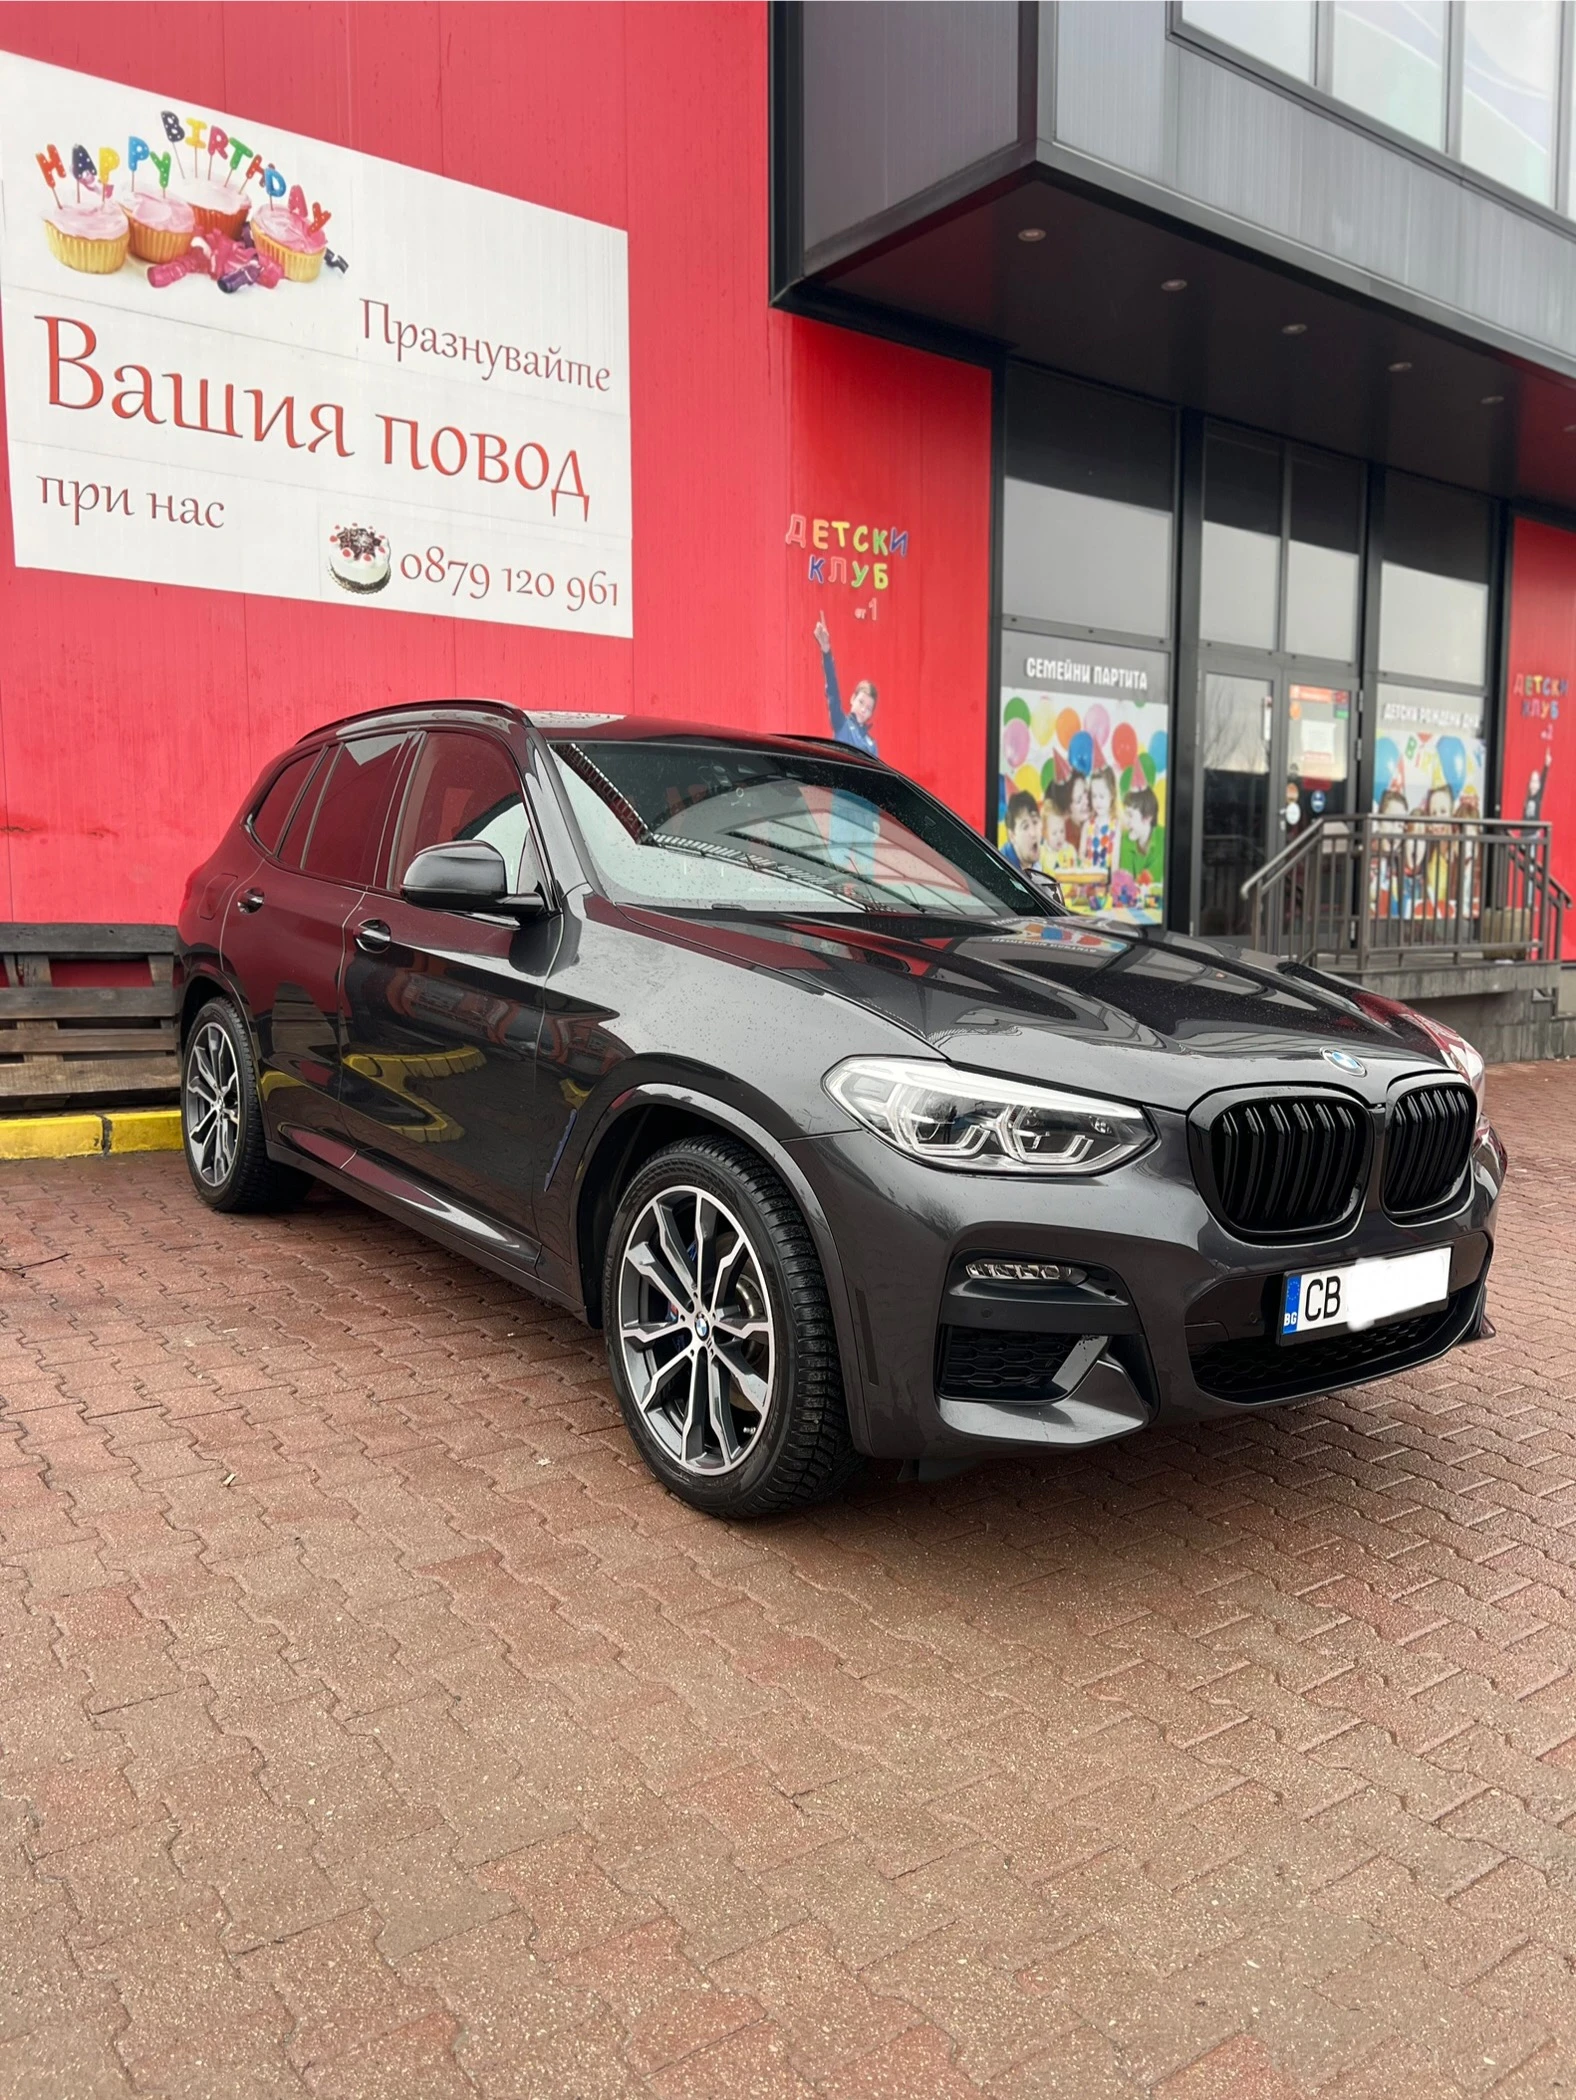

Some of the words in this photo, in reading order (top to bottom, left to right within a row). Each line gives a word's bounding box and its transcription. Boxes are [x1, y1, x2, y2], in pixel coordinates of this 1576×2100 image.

[36, 135, 172, 189] HAPPY
[161, 110, 332, 235] BIRTHDAY
[359, 298, 612, 392] Празнувайте
[34, 315, 355, 458] Вашия
[375, 413, 590, 522] повод
[36, 475, 135, 526] при
[147, 492, 226, 529] нас
[785, 513, 909, 557] ДЕТСКИ
[400, 546, 490, 600] 0879
[501, 568, 555, 598] 120
[566, 570, 618, 612] 961
[808, 554, 889, 590] КЛУБ
[1025, 657, 1091, 684] СЕМЕЙНИ
[1093, 665, 1148, 690] ПАРТИТА
[1283, 1311, 1298, 1327] BG
